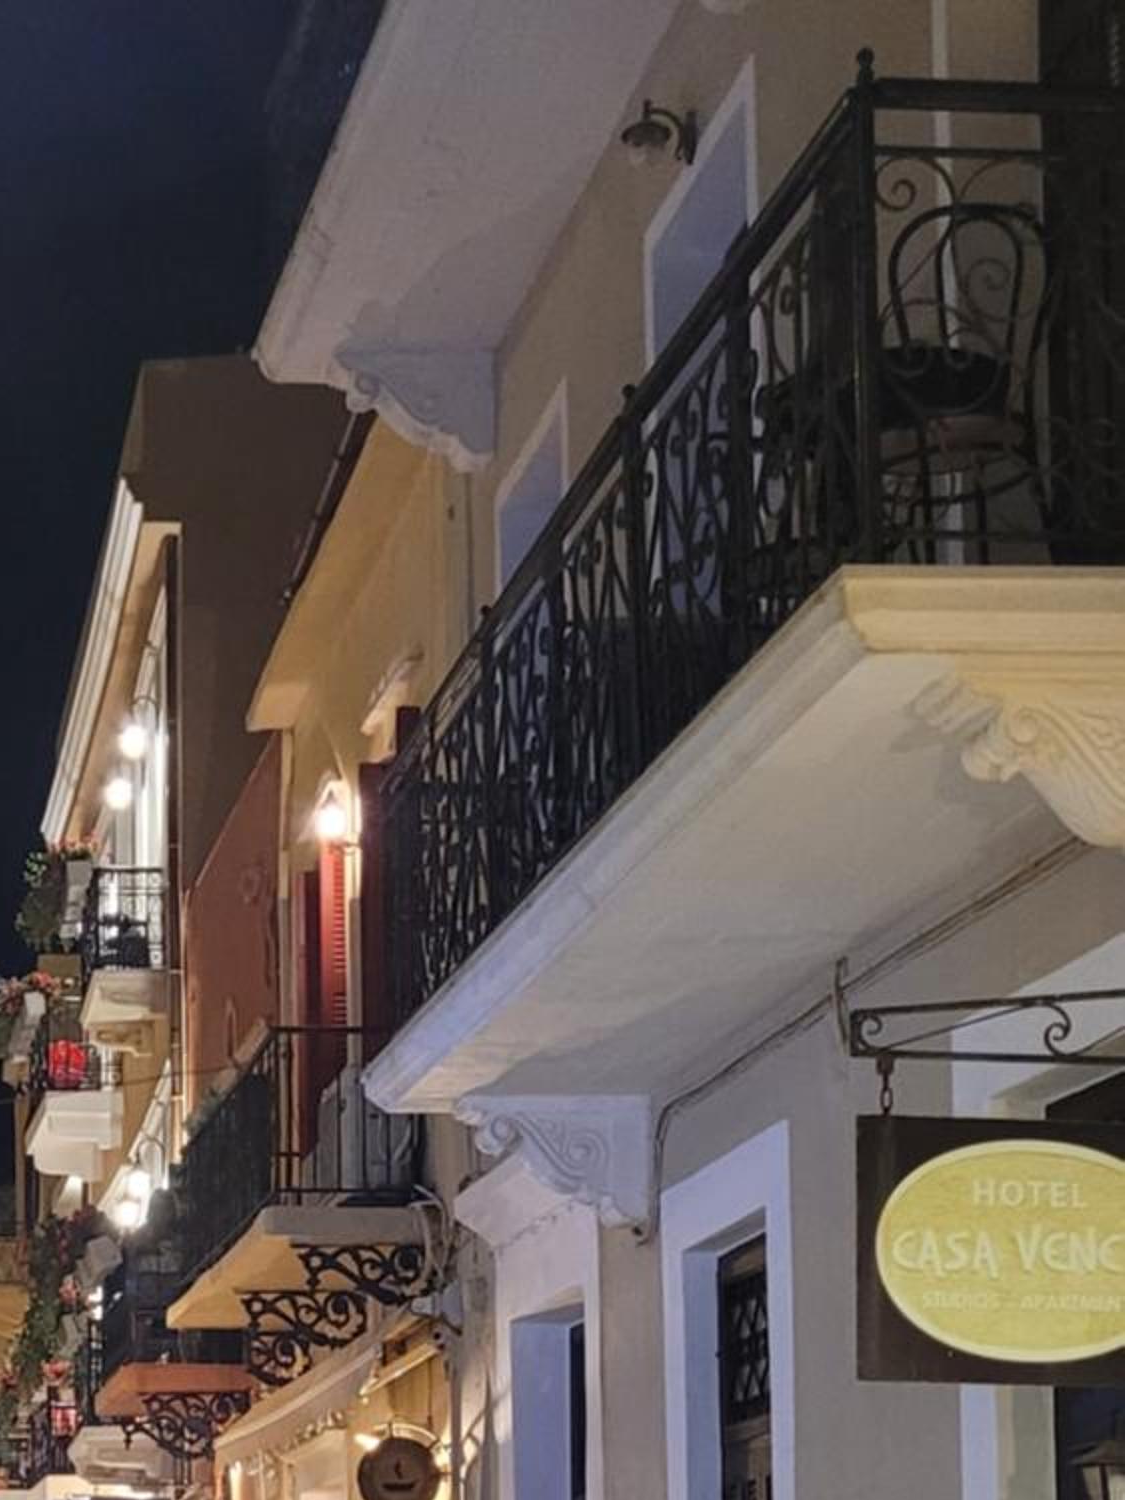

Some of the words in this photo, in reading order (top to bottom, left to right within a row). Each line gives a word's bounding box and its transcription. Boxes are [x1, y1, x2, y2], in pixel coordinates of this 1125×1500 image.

[974, 1179, 1088, 1208] HOTEL
[892, 1228, 1001, 1280] CASA
[1021, 1294, 1125, 1312] APARTMEN
